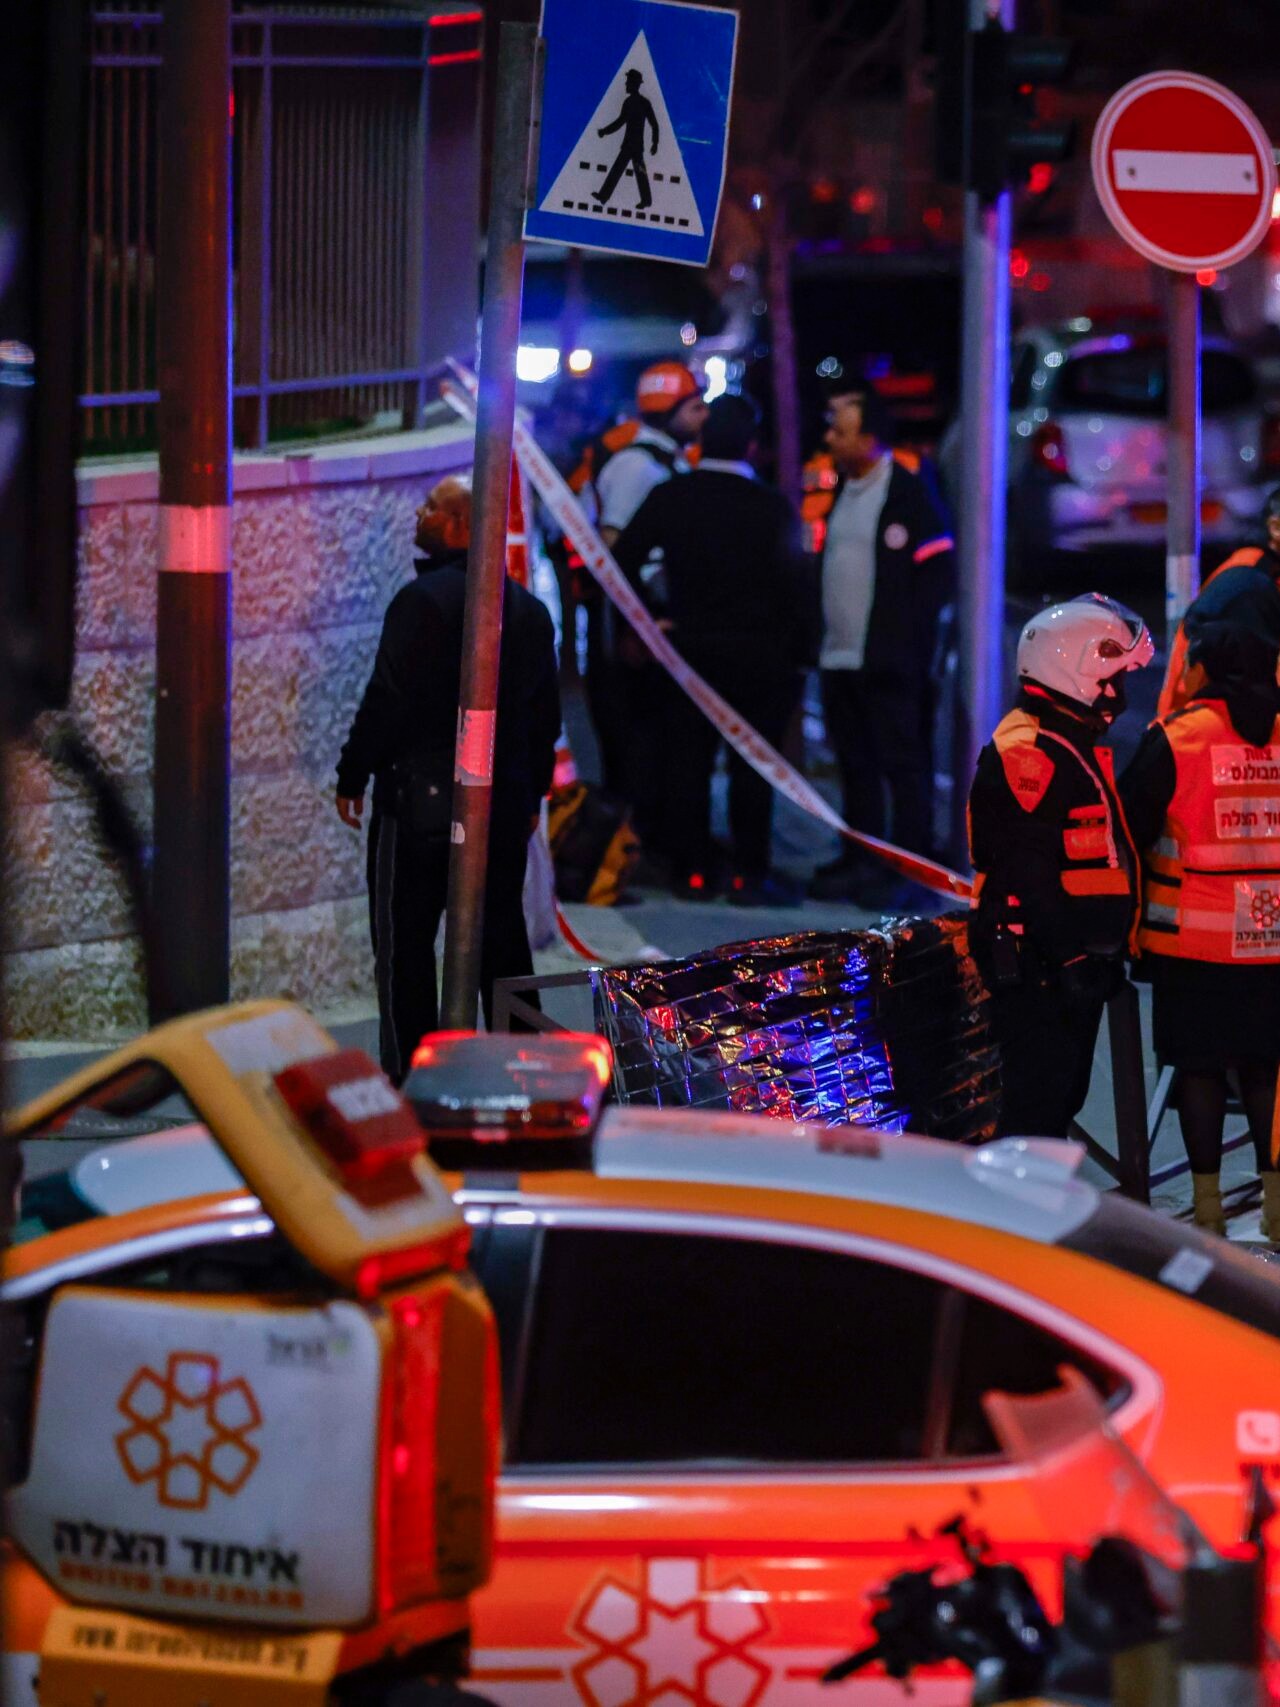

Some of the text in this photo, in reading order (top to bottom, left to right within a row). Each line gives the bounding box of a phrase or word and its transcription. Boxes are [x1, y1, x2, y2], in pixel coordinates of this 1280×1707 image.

[1220, 810, 1258, 828] הצלה
[53, 1518, 300, 1583] איחוד הצלה
